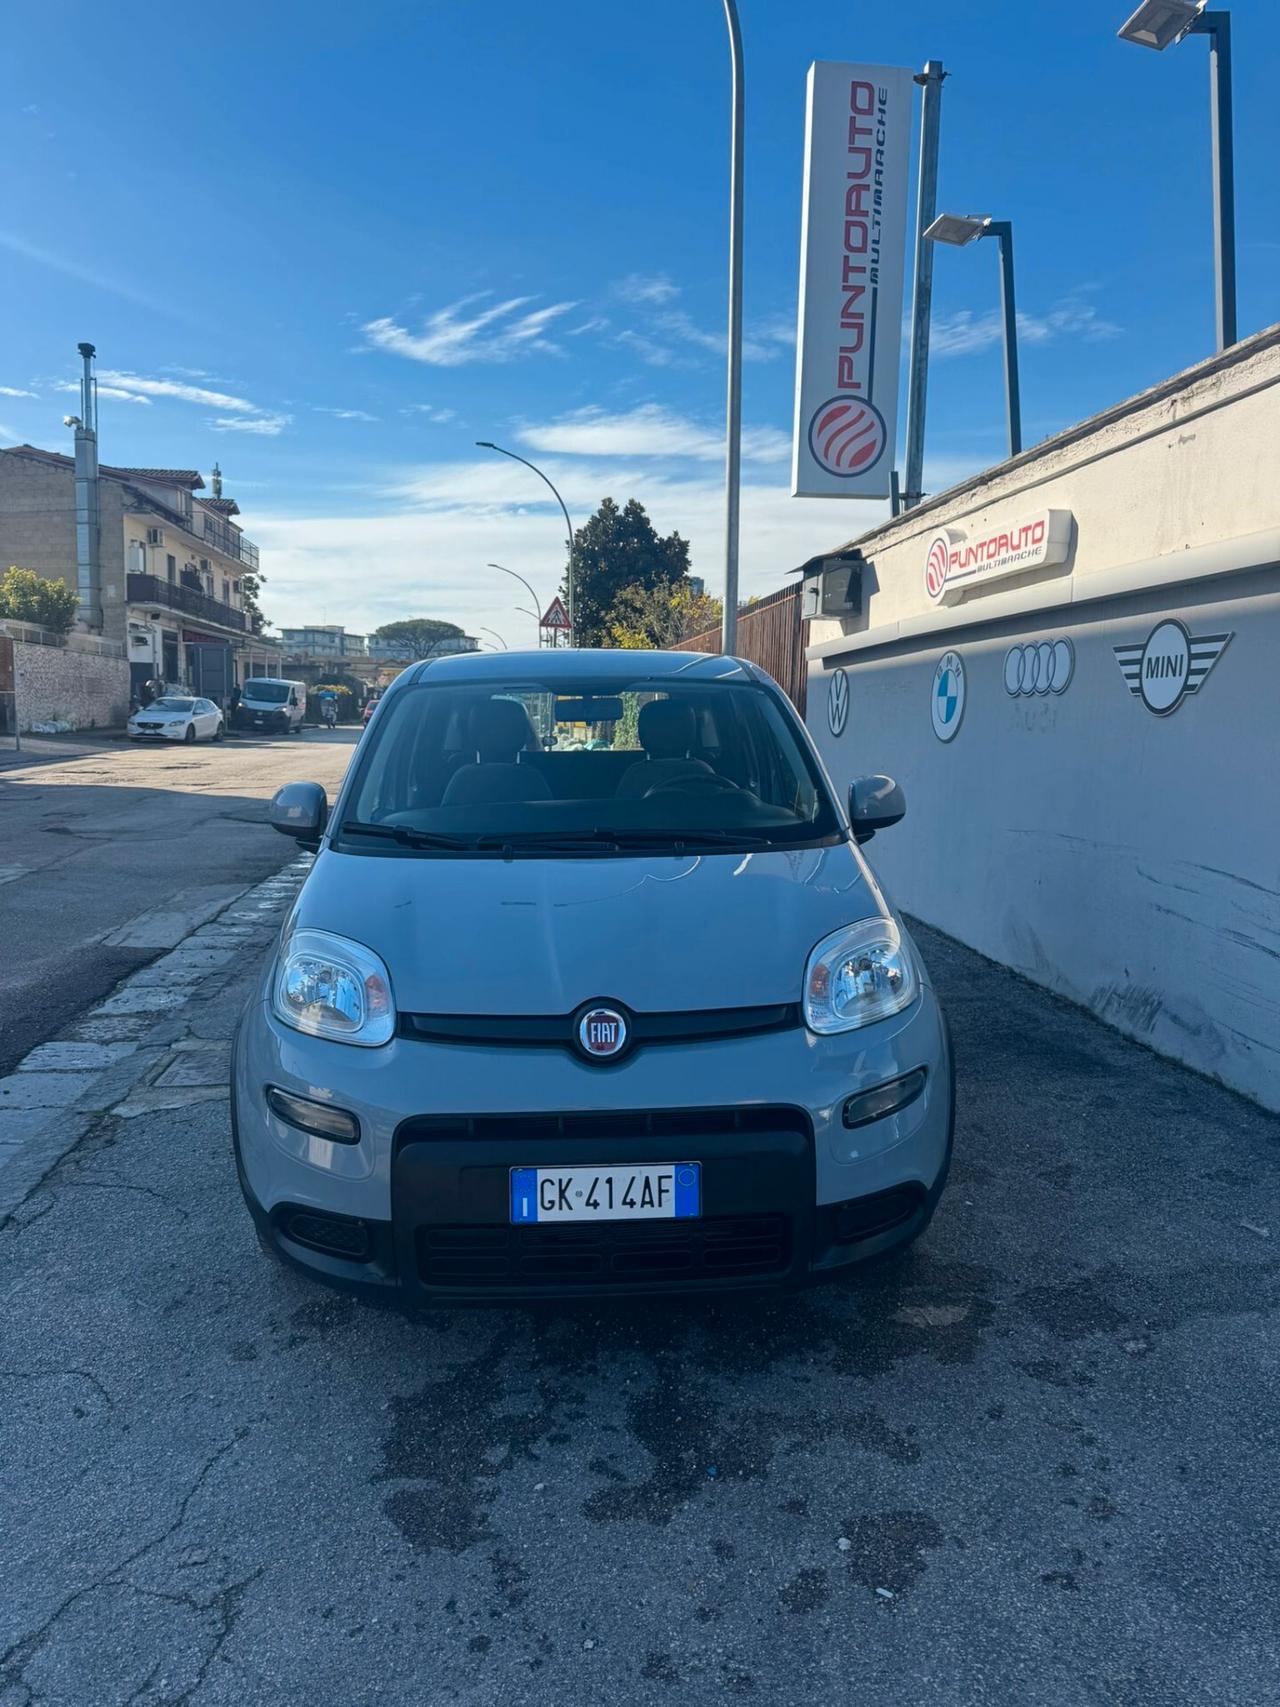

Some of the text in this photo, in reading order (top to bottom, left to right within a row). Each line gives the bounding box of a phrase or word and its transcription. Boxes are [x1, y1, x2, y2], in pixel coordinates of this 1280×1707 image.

[869, 87, 888, 285] MULTIMARCHE
[838, 80, 875, 389] PUNTOAUTO
[948, 520, 1045, 573] PUNTOAUTO
[1145, 654, 1184, 679] MINI
[590, 1022, 617, 1043] FIAT
